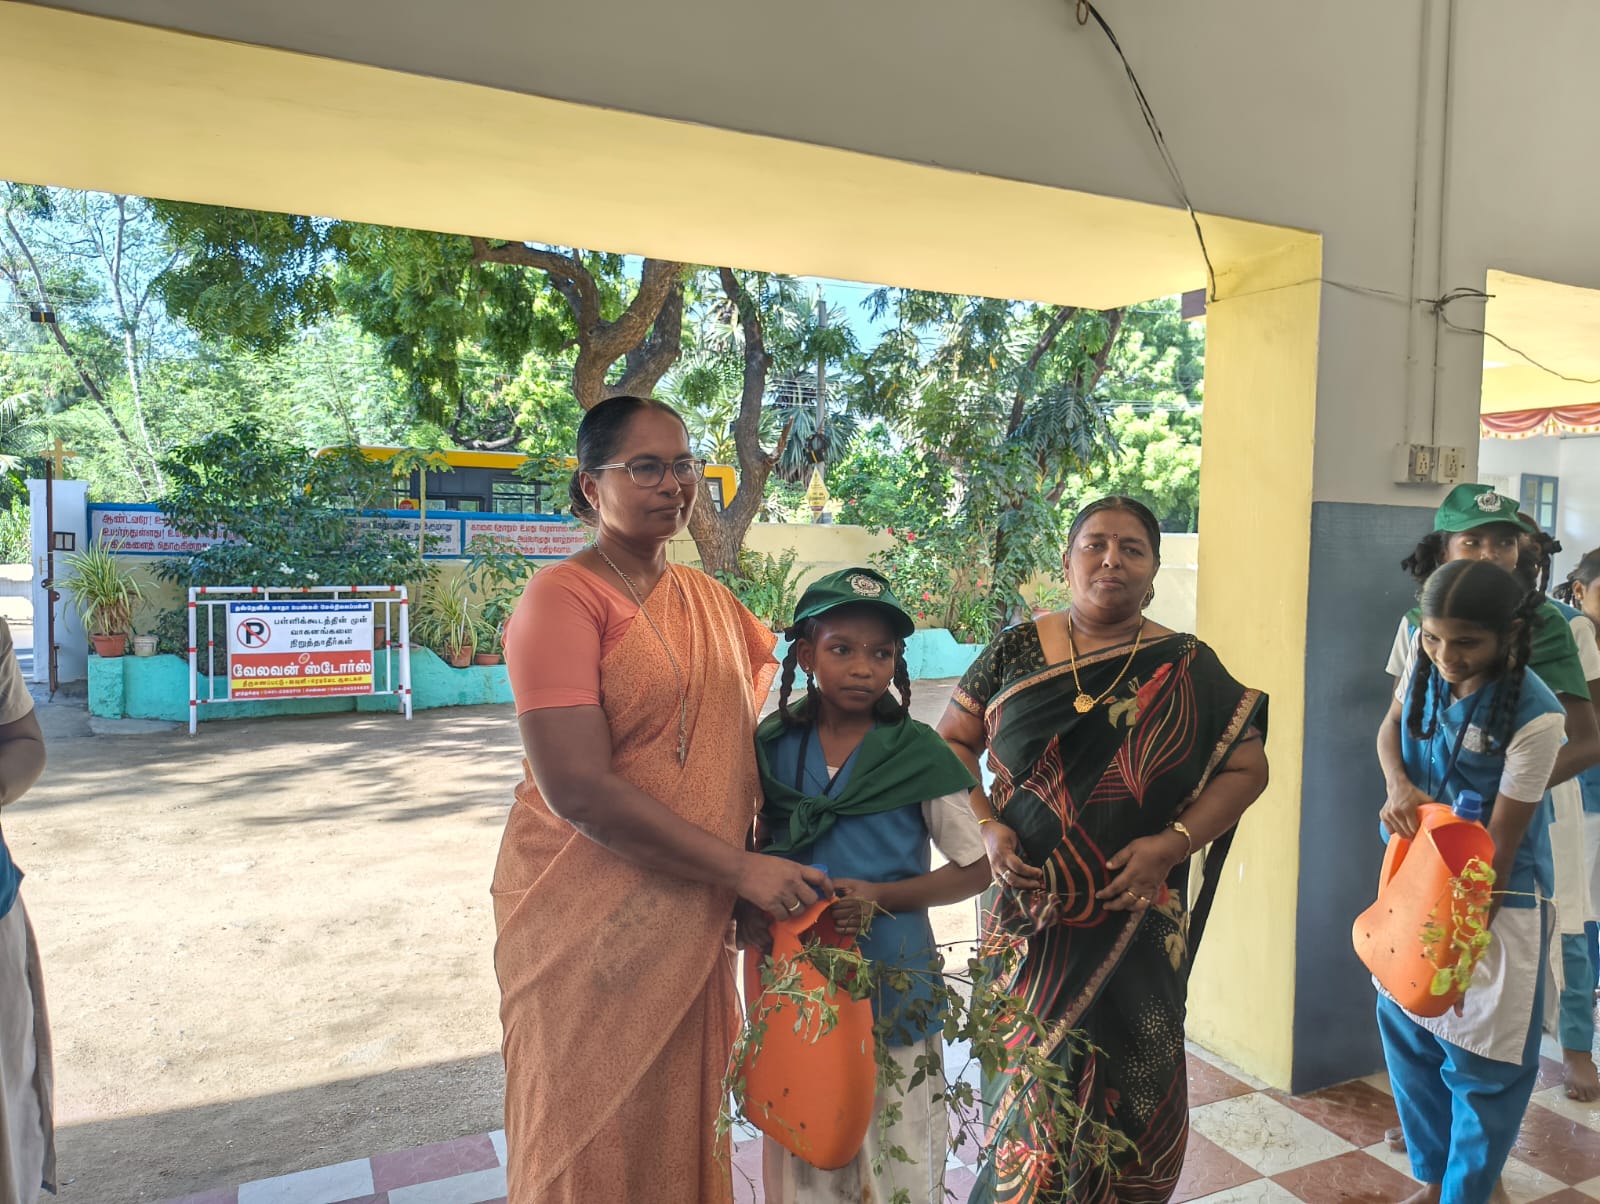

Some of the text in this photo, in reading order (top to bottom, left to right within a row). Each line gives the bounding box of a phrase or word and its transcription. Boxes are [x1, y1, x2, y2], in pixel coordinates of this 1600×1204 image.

[274, 615, 368, 625] பள்ளிக்கூடத்தின் முன்
[290, 627, 353, 635] வாகனங்களை
[289, 637, 353, 649] நிறுத்தாதீர்கள்
[233, 659, 371, 678] வேலவன் ஸ்டோர்ஸ்
